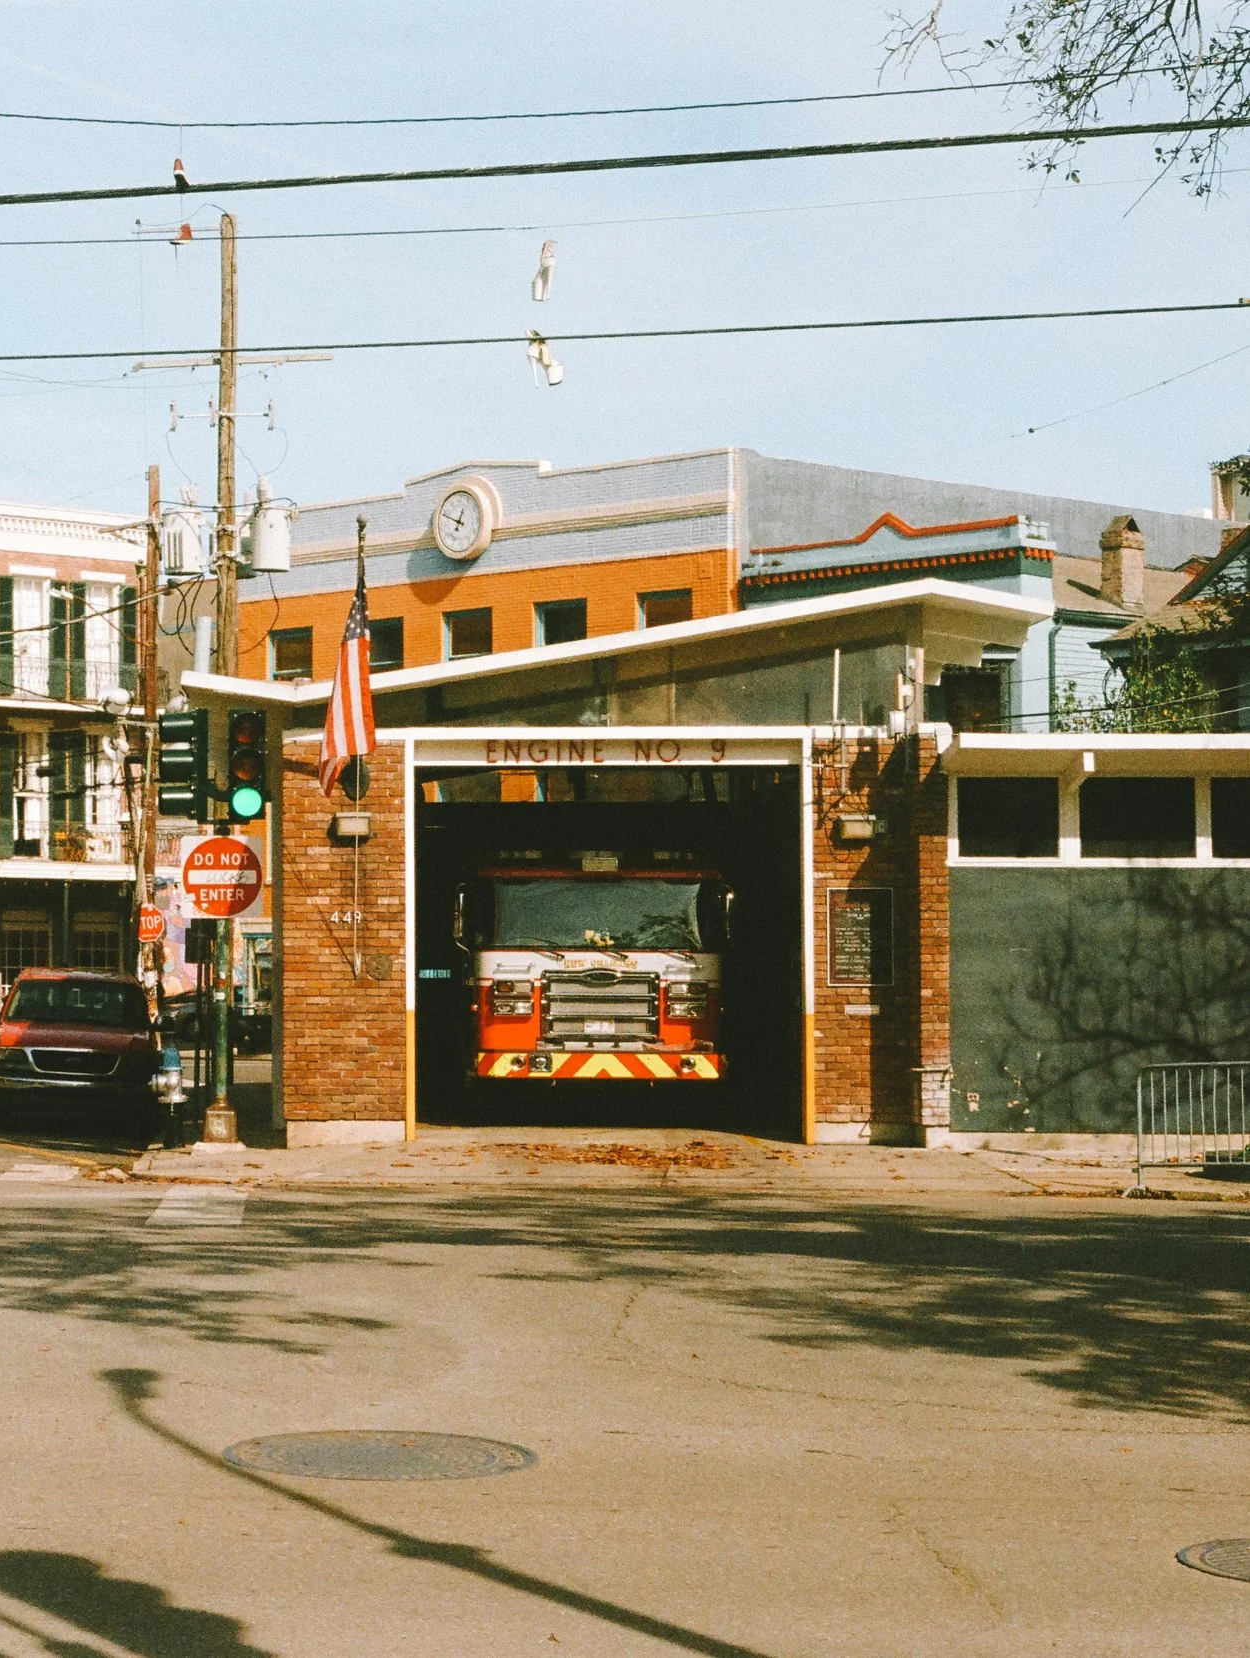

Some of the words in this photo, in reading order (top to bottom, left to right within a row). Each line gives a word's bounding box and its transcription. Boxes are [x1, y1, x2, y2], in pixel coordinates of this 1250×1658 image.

[486, 739, 605, 764] ENGINE
[710, 739, 726, 763] 9
[194, 853, 214, 866] DO
[220, 853, 249, 866] NOT
[200, 888, 244, 901] ENTER
[140, 915, 161, 930] TOP
[330, 910, 362, 924] 449
